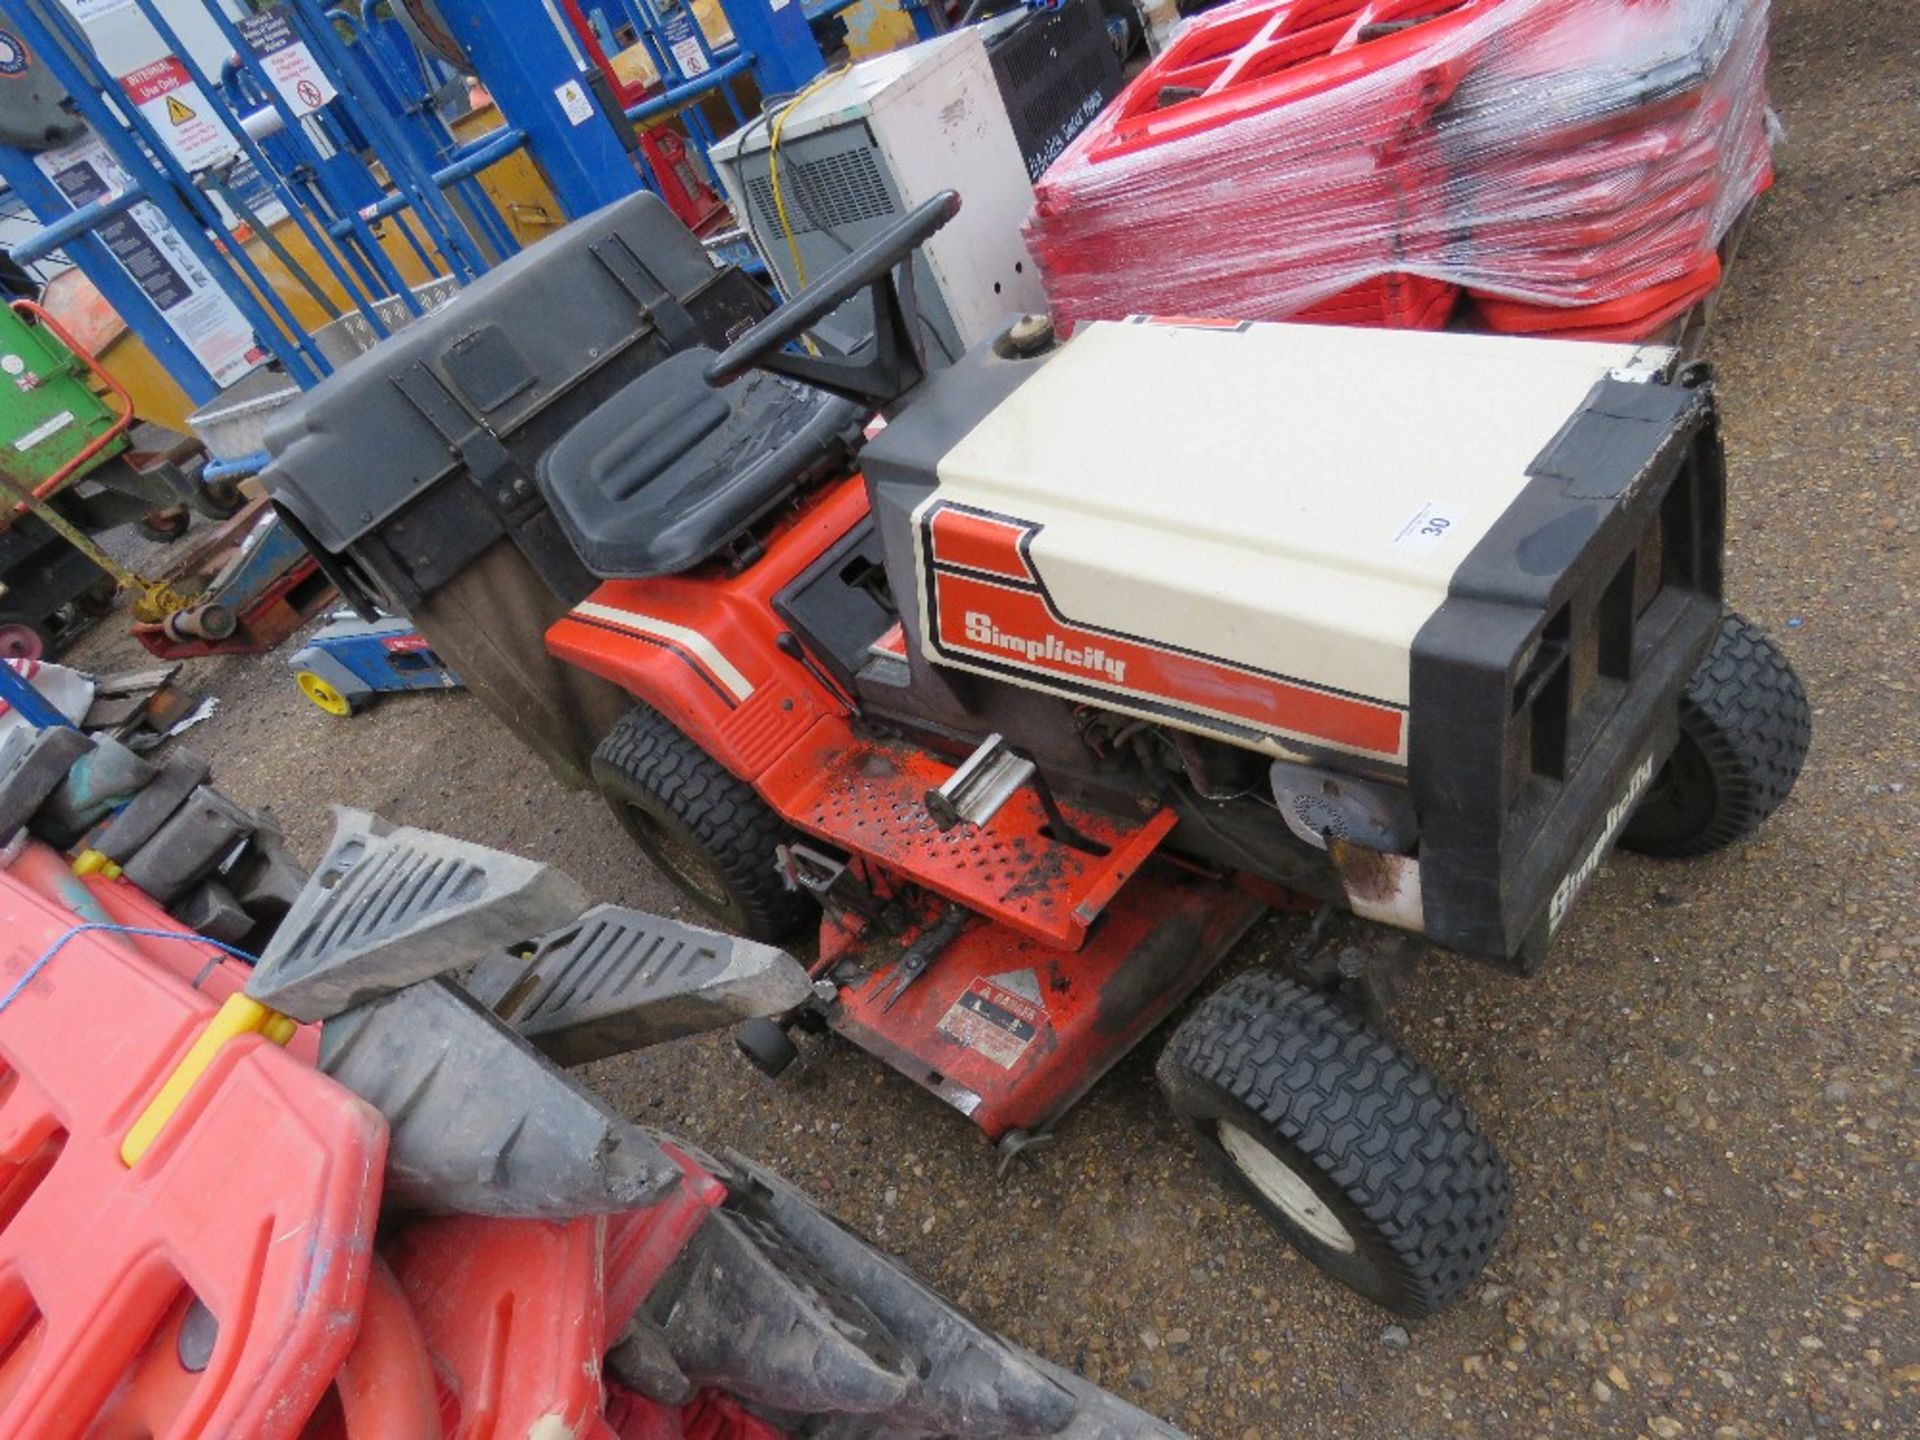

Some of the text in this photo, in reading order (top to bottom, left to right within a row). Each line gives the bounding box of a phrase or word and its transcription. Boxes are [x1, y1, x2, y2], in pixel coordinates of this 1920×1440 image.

[139, 76, 181, 98] Use Only
[1421, 517, 1450, 536] 30
[965, 610, 1126, 682] Simplicity
[1549, 752, 1654, 935] Simplicity
